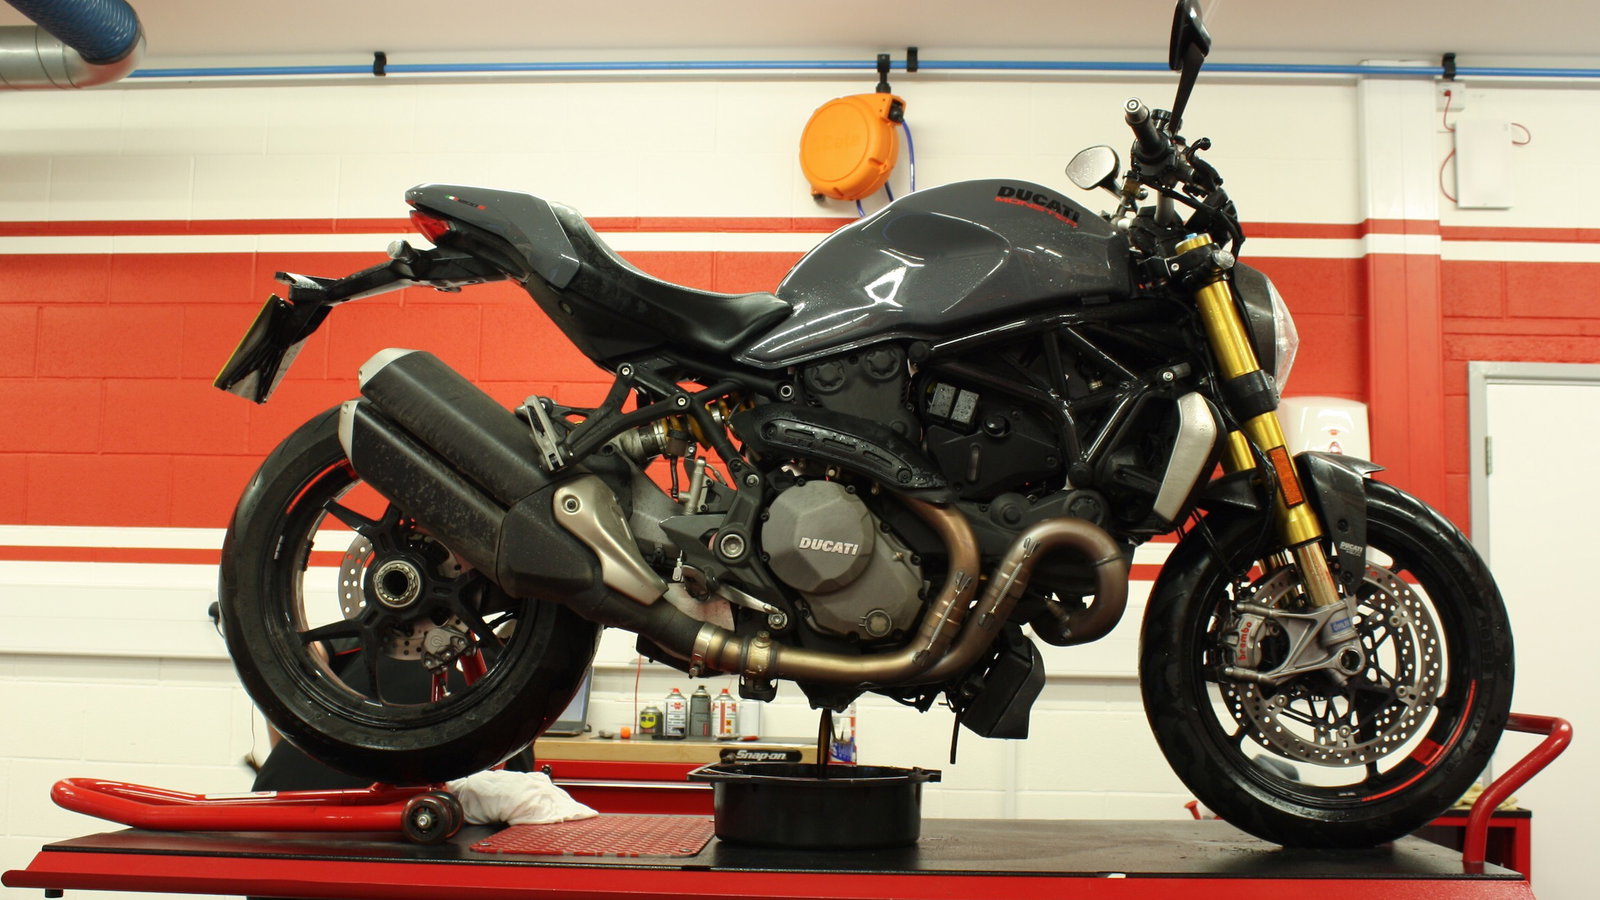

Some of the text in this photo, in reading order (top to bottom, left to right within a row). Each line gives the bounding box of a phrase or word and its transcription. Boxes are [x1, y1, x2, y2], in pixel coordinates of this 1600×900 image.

[997, 186, 1080, 223] DUCATI
[799, 537, 859, 556] DUCATI
[1238, 621, 1252, 661] brembo
[736, 750, 786, 761] Snap-on
